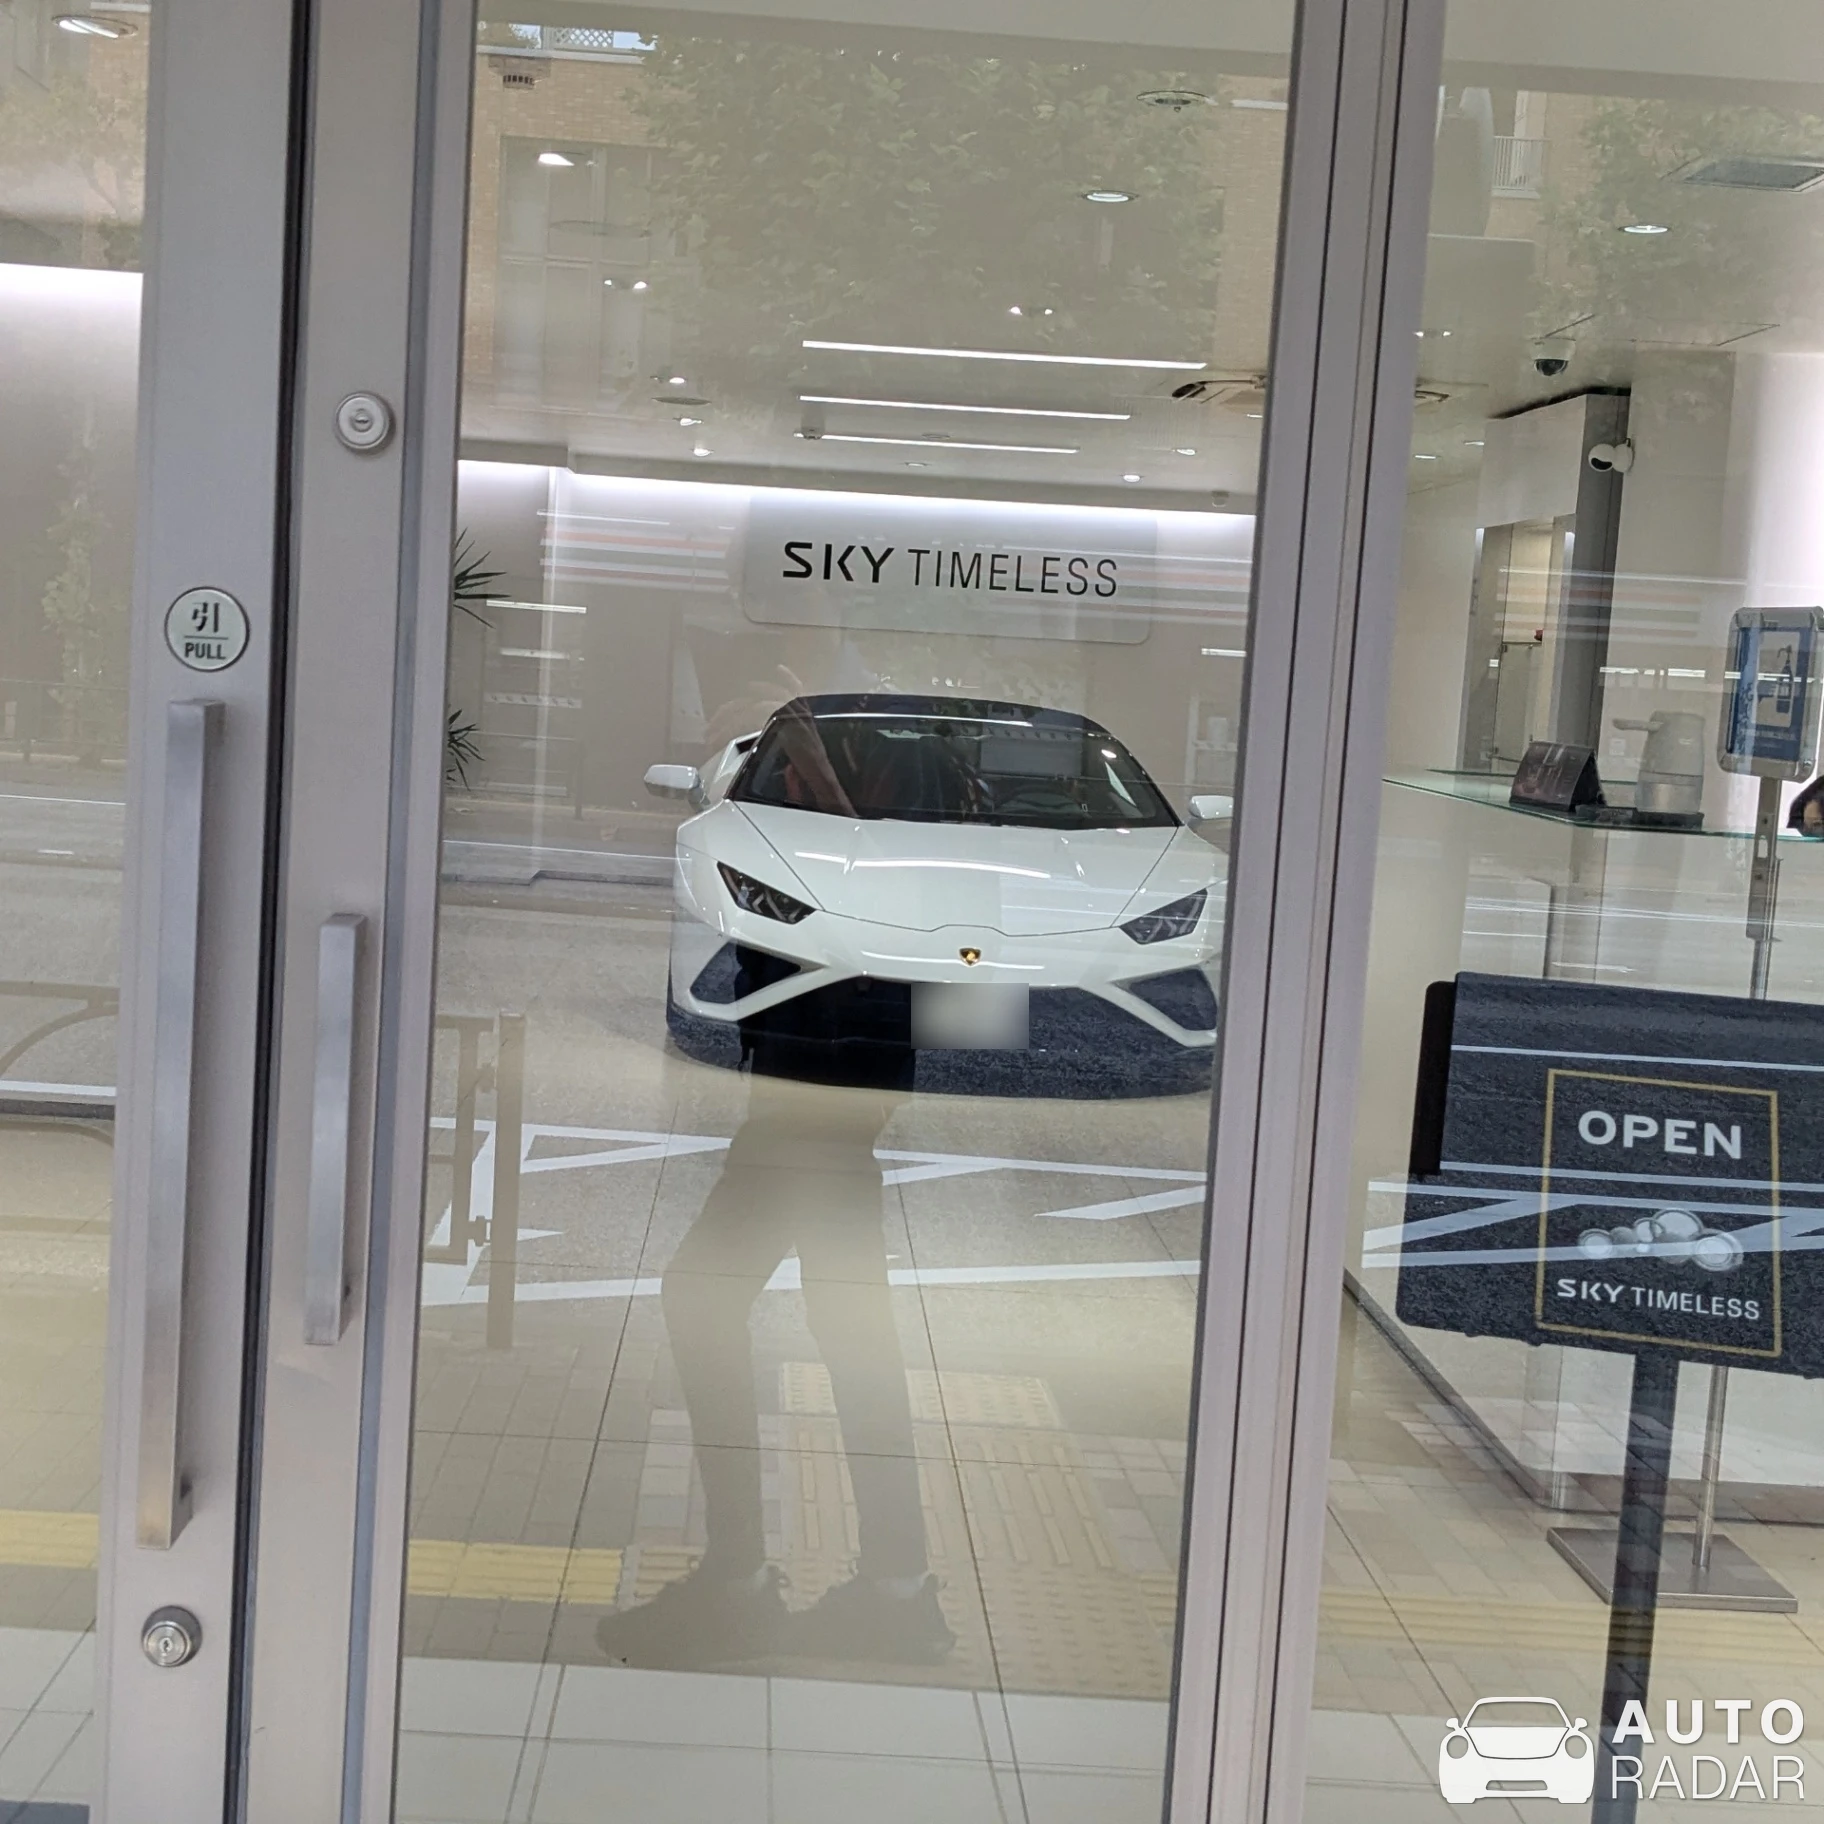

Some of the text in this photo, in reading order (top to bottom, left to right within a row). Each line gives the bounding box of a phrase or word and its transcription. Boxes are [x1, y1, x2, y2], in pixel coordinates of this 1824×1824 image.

[782, 541, 1117, 597] SKY TIMELESS
[191, 602, 220, 633] 引
[184, 642, 226, 660] PULL
[1578, 1110, 1742, 1159] OPEN
[1557, 1278, 1760, 1320] SKY TIMELESS
